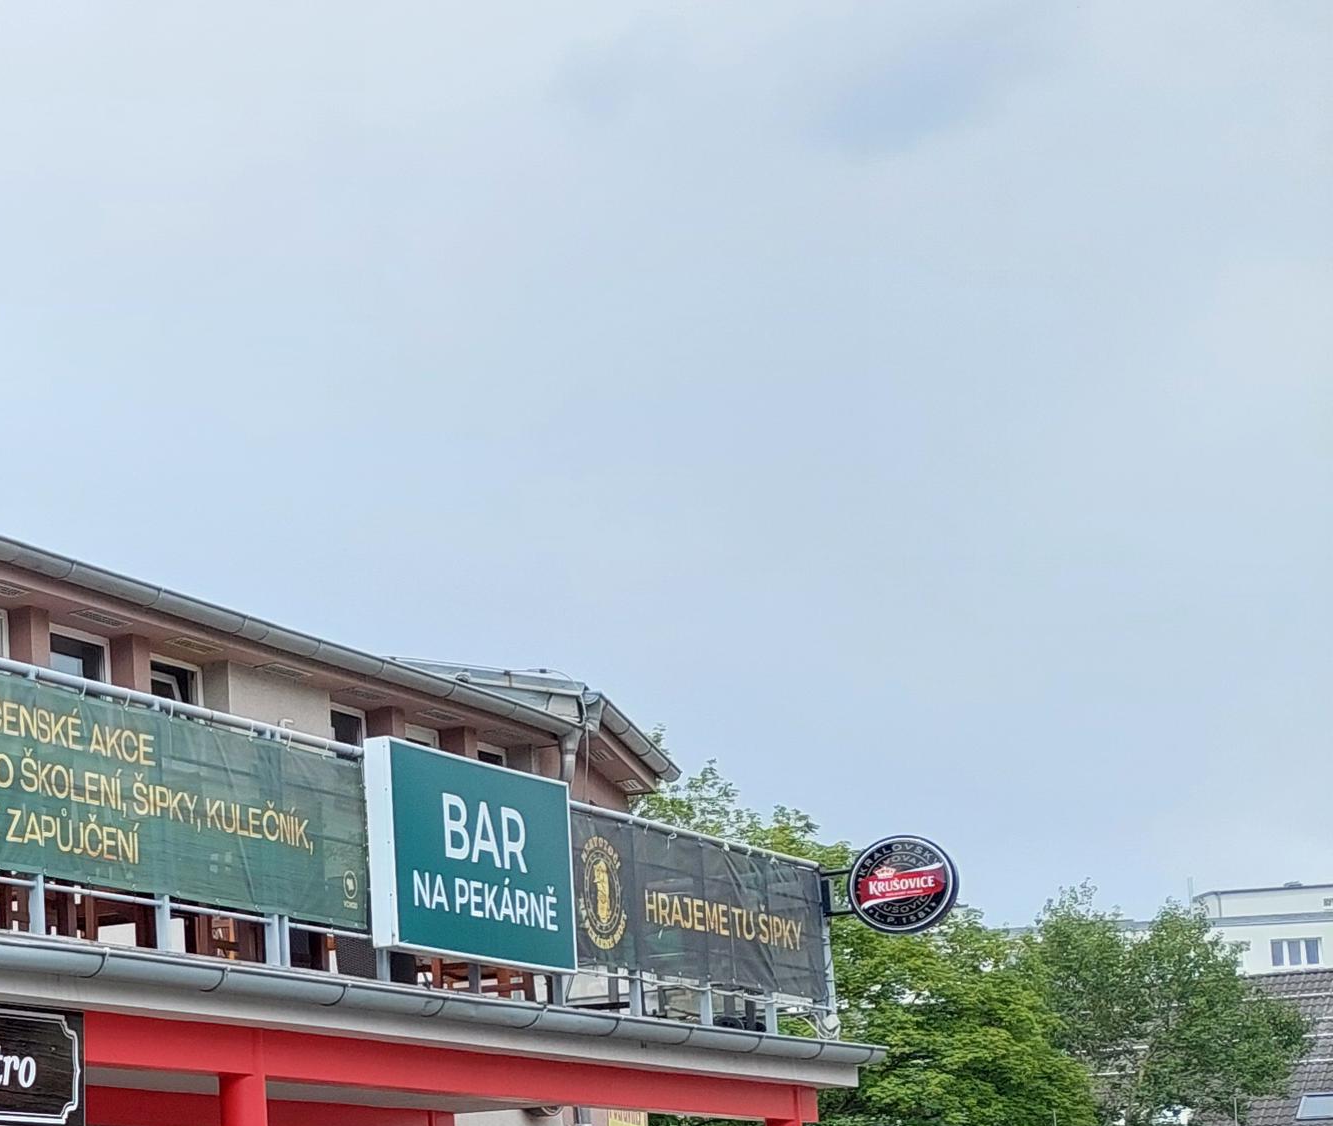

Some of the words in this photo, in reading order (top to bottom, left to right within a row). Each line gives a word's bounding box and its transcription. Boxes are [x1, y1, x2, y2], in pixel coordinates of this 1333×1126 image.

[89, 723, 156, 767] AKCE
[20, 748, 127, 818] ŠKOLENÍ,
[133, 772, 201, 833] ŠIPKY,
[206, 800, 314, 855] KULEČNÍK,
[6, 807, 140, 865] ZAPŮJČENÍ
[441, 792, 528, 874] BAR
[413, 870, 450, 911] NA
[454, 877, 559, 932] PEKÁRNĚ
[868, 875, 935, 896] KRUŠOVICE
[645, 888, 730, 936] HRAJEME
[730, 907, 756, 942] TU
[758, 903, 803, 952] ŠIPKY
